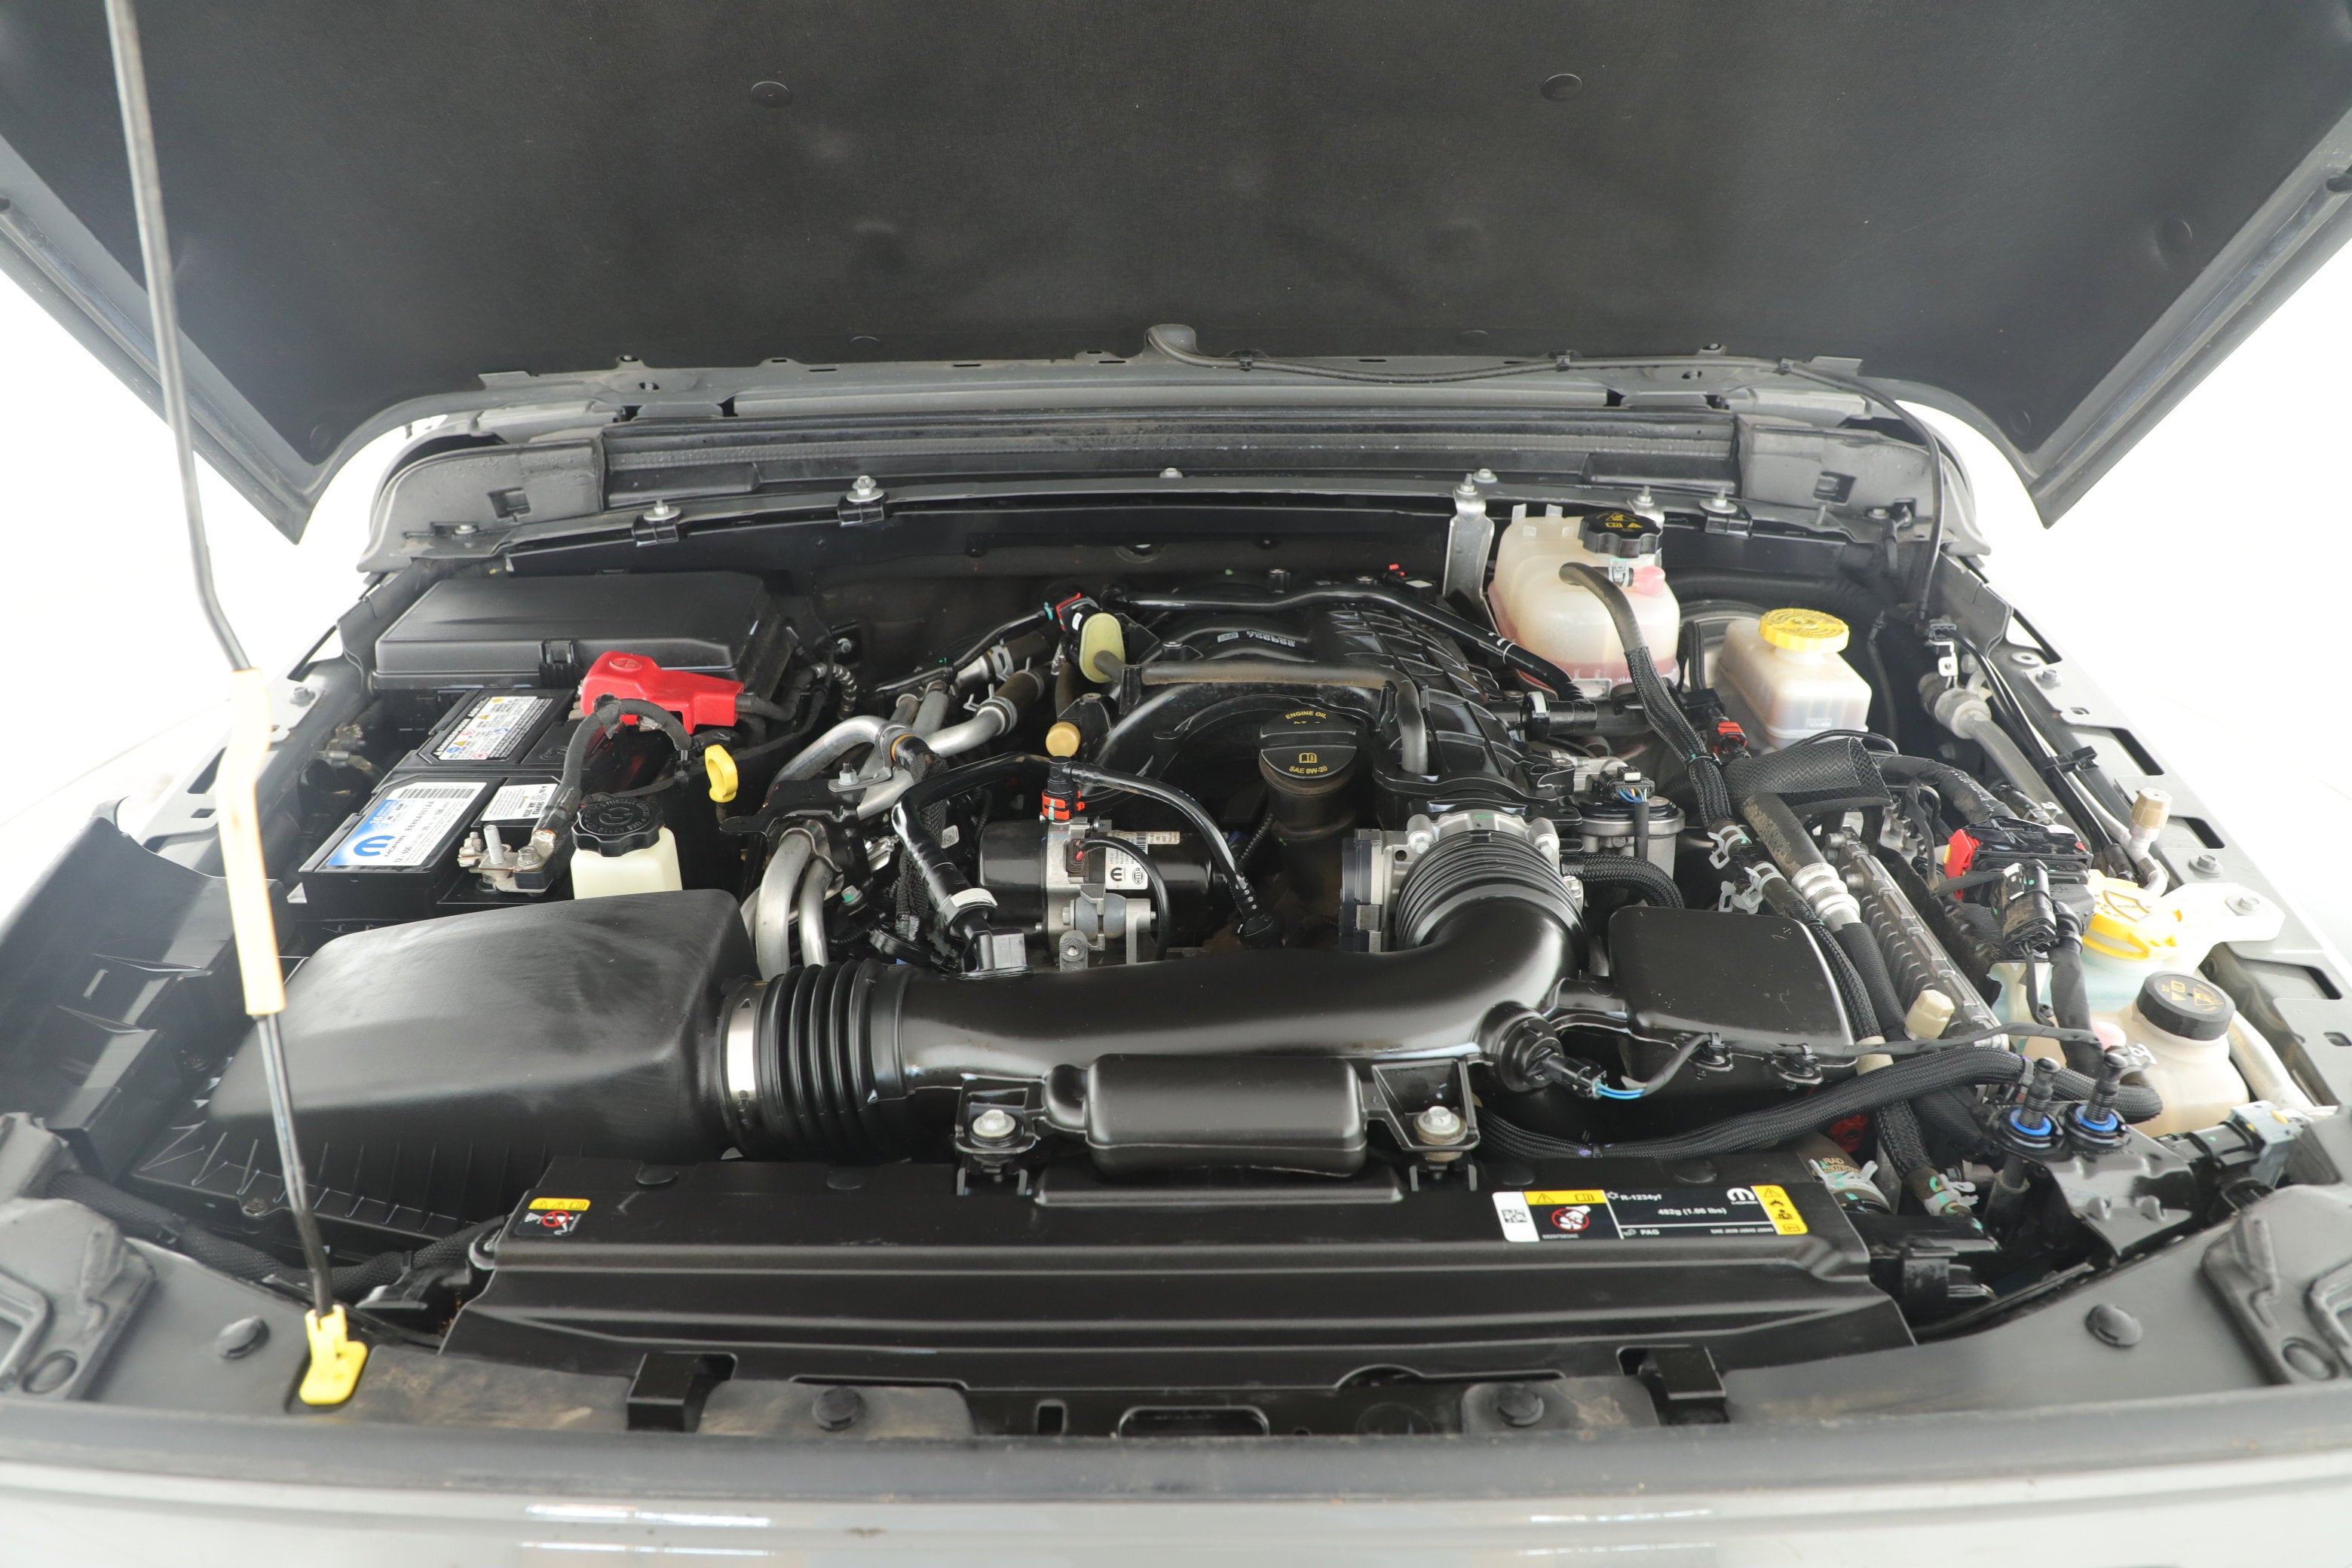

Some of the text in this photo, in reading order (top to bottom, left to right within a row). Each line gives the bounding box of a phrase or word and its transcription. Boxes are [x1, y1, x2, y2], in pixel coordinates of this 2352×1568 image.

[1285, 710, 1314, 720] ENGINE
[1289, 766, 1328, 774] SAE 0W-20
